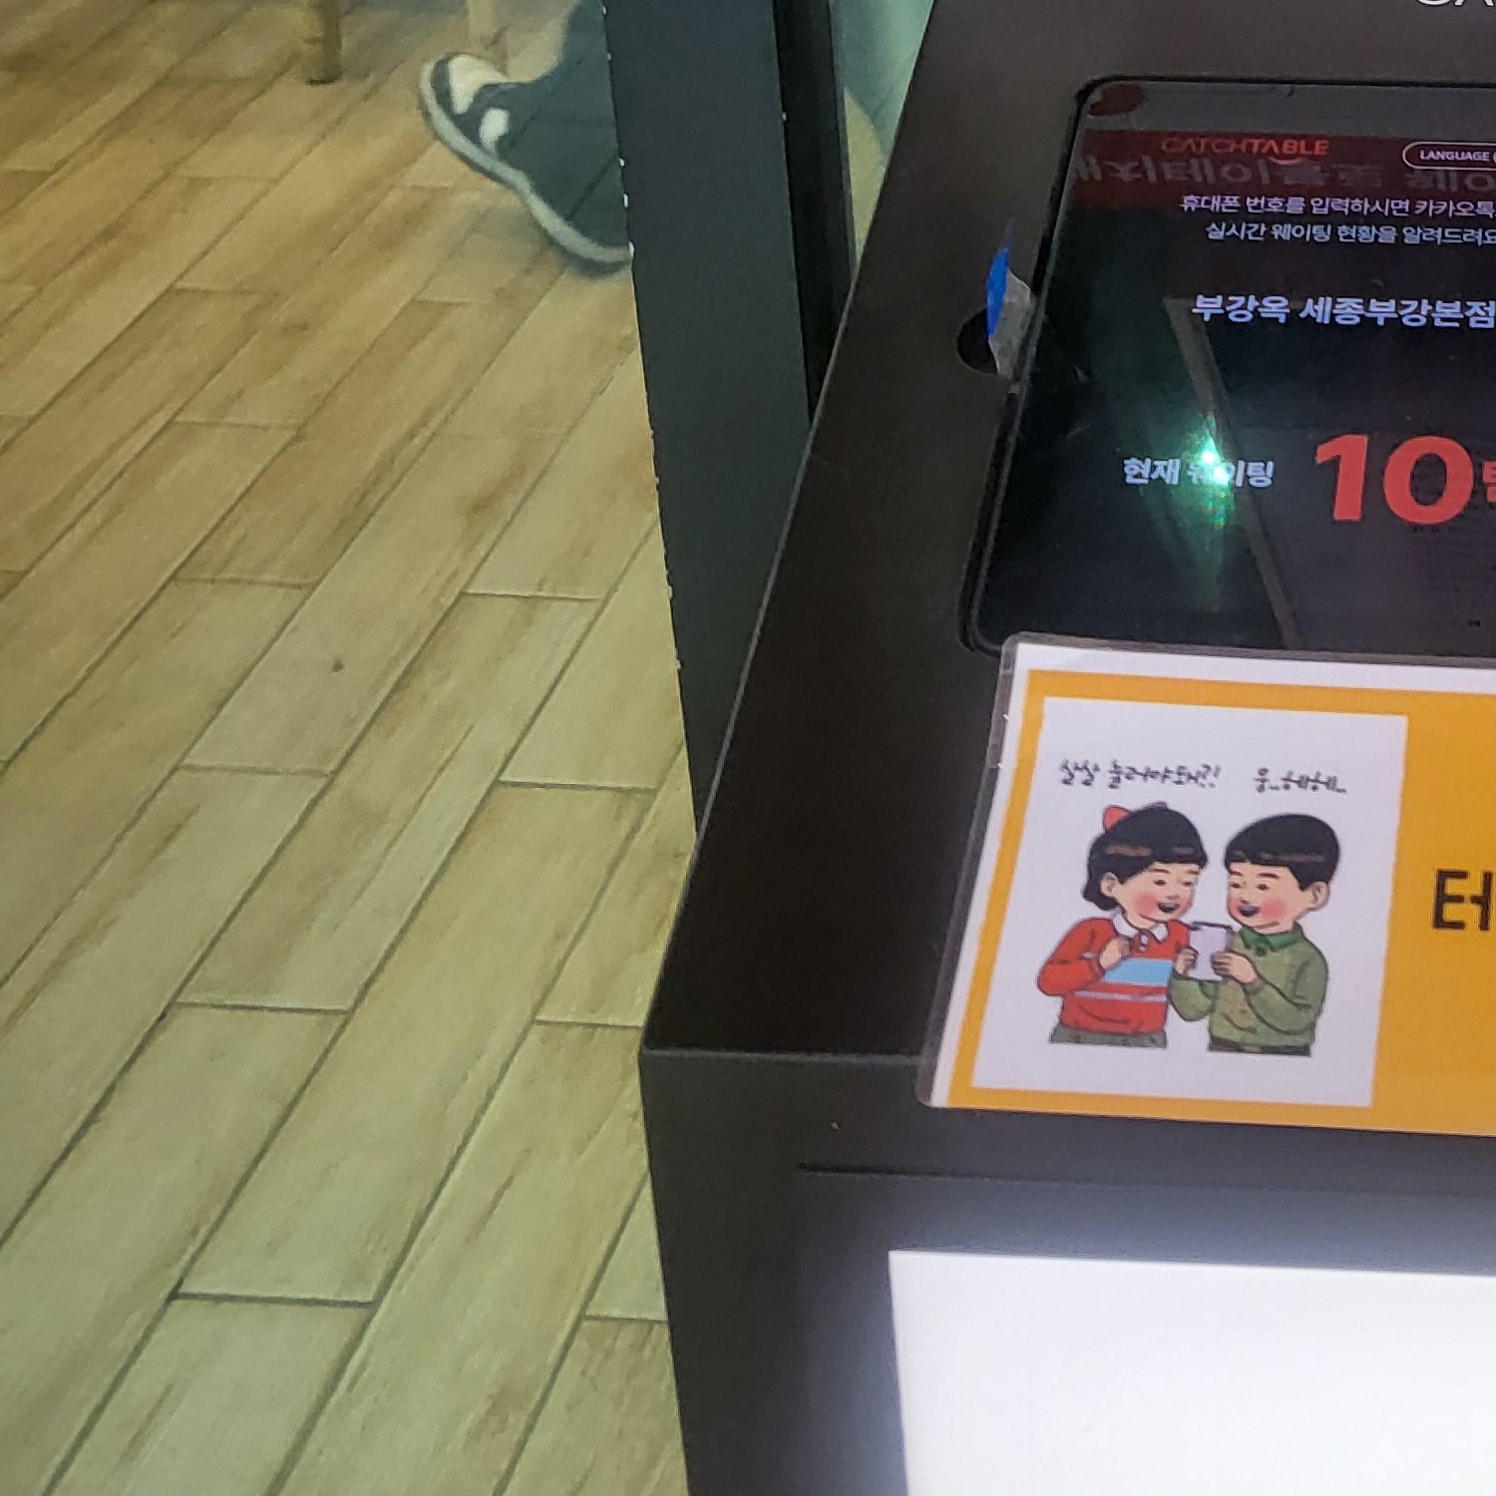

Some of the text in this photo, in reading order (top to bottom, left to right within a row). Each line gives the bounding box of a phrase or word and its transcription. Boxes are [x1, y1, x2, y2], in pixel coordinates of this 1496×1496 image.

[1161, 136, 1329, 157] CATCHTABLE
[1419, 149, 1491, 163] LANGUAGE
[1181, 195, 1241, 213] 휴대폰
[1246, 196, 1305, 215] 번호를
[1310, 197, 1409, 217] 입력하시면
[1205, 221, 1266, 241] 실시간
[1271, 223, 1331, 243] 웨이팅
[1337, 224, 1397, 245] 현황을
[1190, 293, 1290, 325] 부강옥
[1123, 457, 1181, 486] 현재
